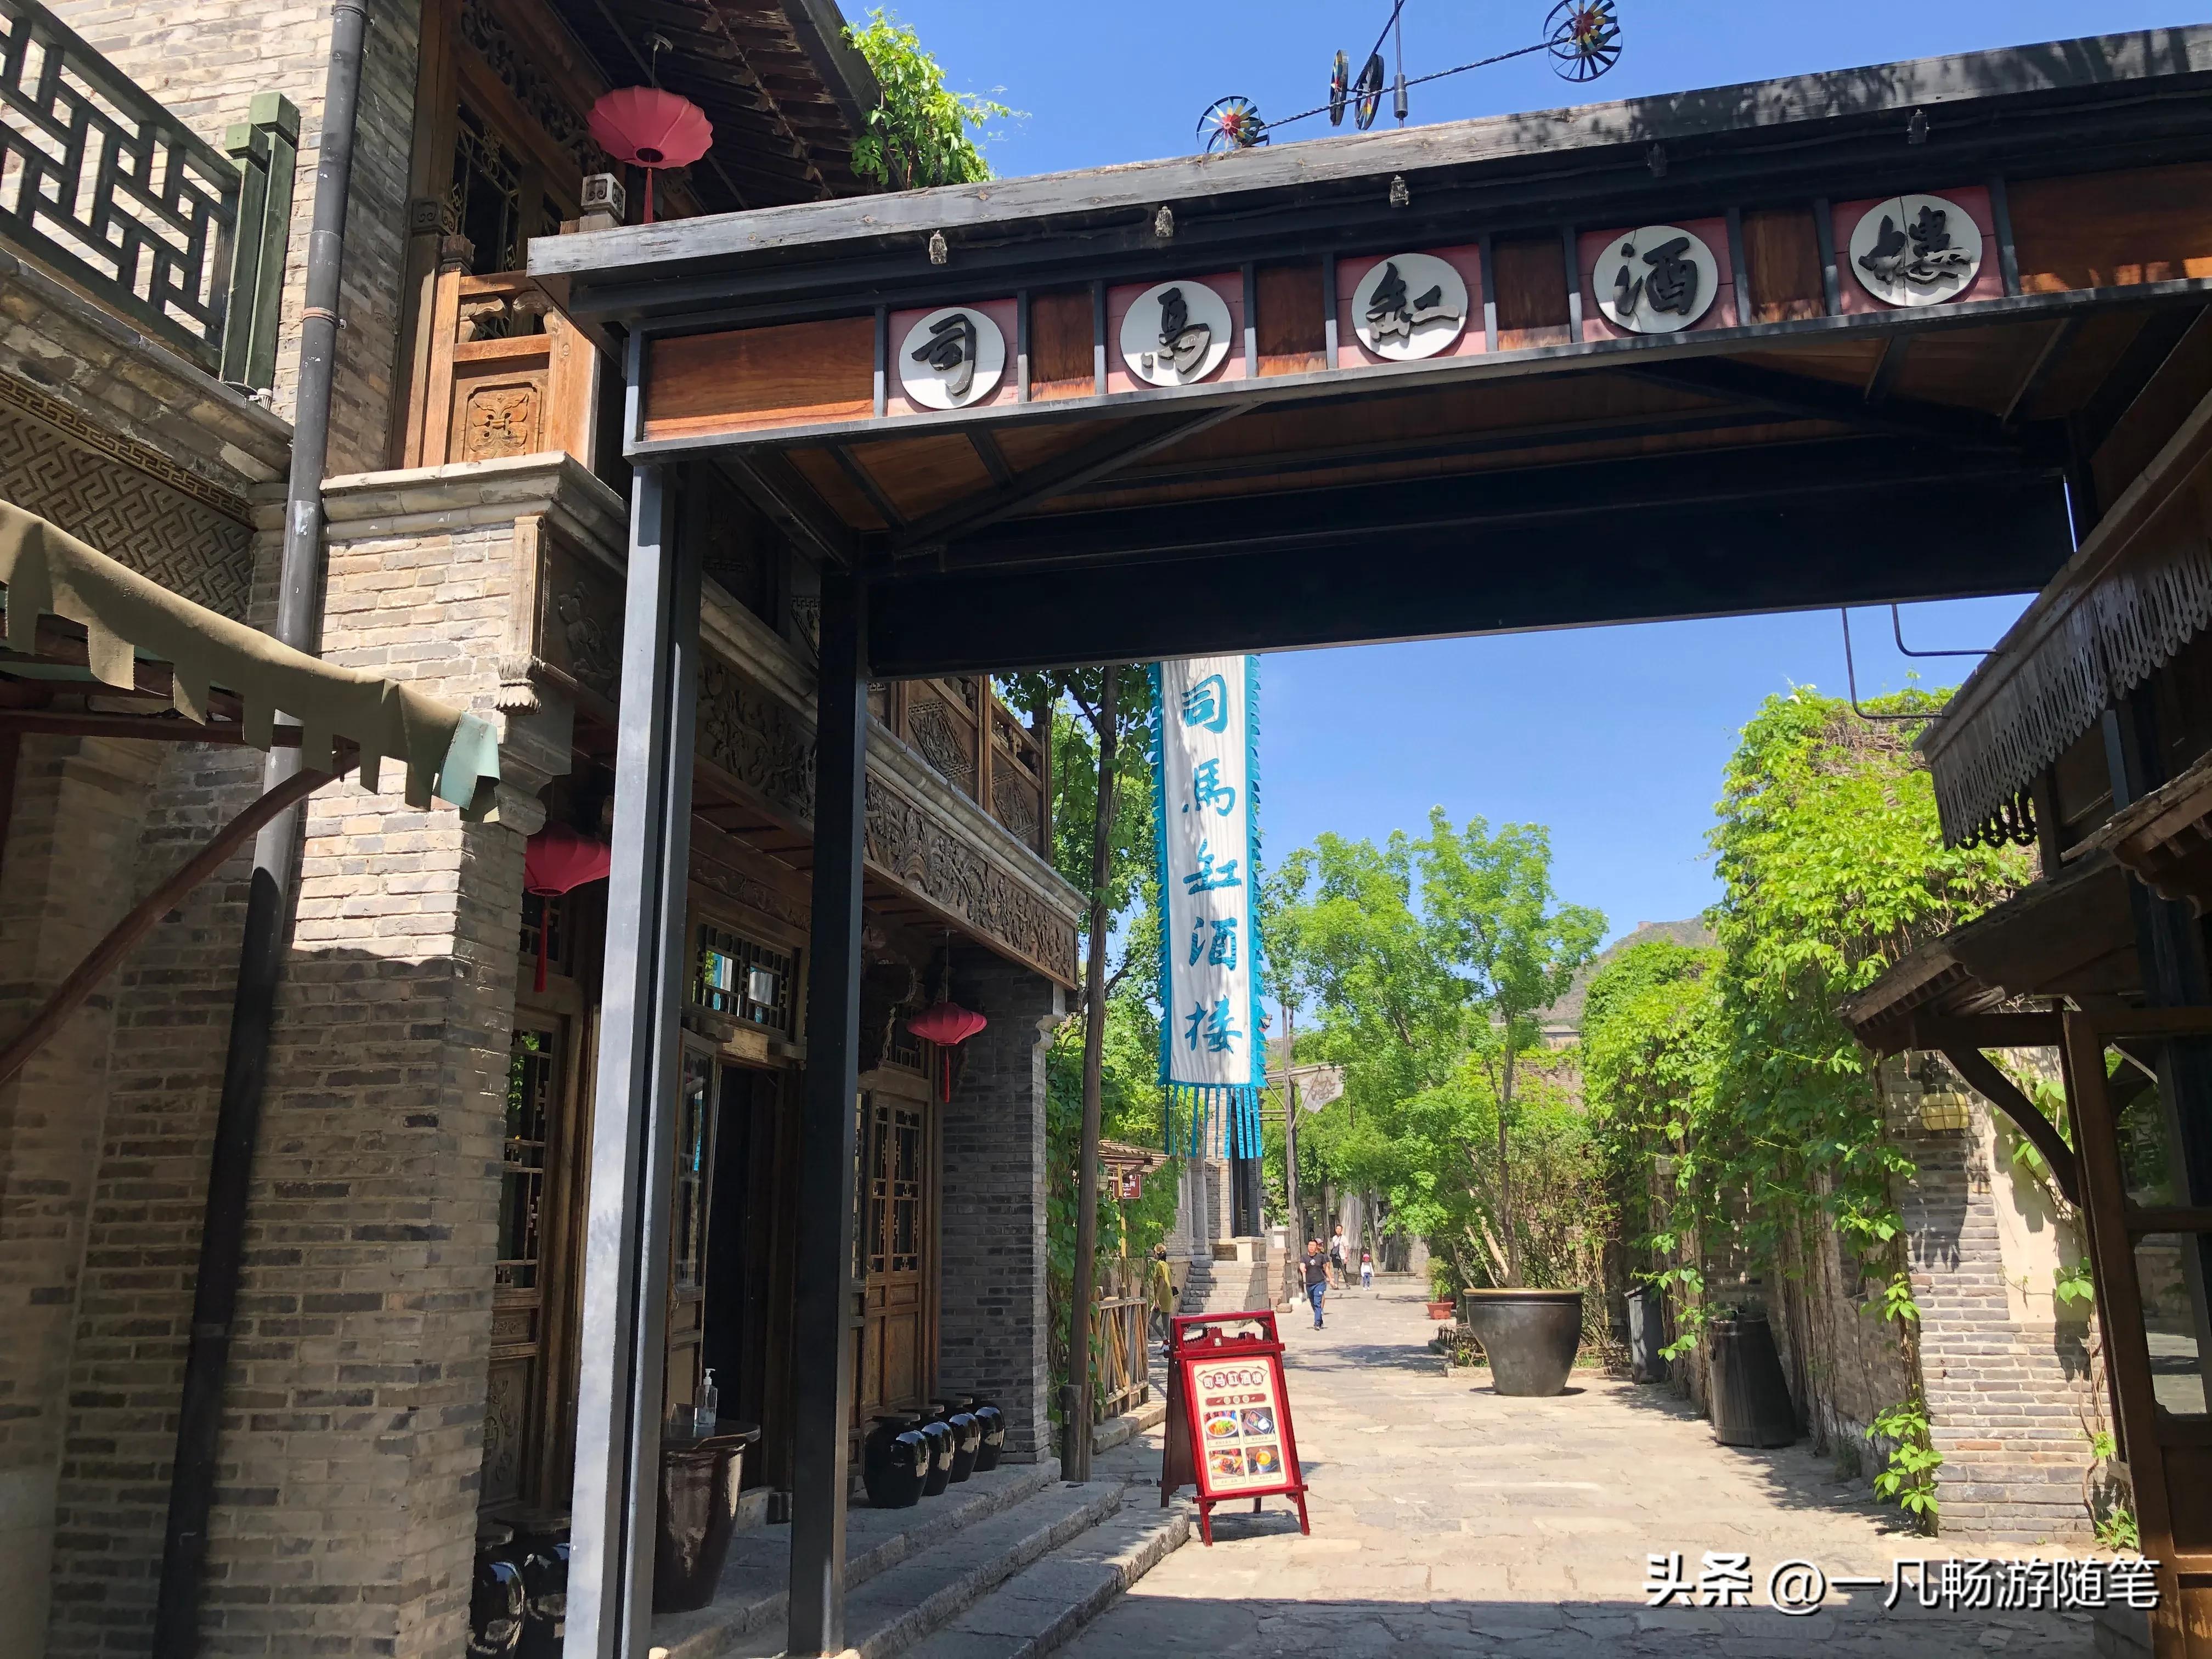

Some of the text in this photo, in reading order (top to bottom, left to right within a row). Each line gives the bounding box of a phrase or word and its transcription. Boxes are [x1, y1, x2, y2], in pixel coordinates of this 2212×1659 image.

[1203, 1371, 1263, 1389] 司马缸酒楼
